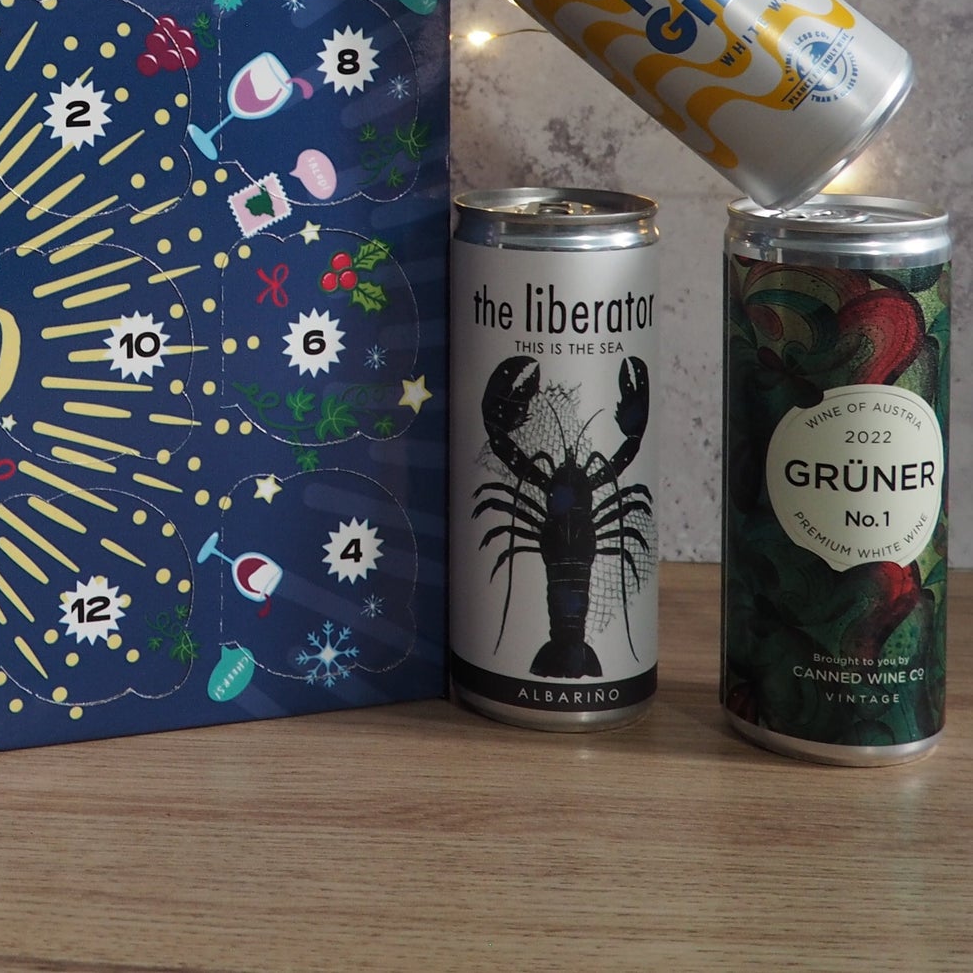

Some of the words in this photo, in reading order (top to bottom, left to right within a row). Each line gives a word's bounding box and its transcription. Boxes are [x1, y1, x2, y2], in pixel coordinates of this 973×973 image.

[720, 13, 769, 66] WHITE
[337, 48, 360, 75] 8
[65, 100, 91, 128] 2
[473, 284, 513, 330] the
[526, 283, 655, 334] liberator
[119, 331, 160, 359] 10
[303, 330, 326, 355] 6
[515, 340, 544, 354] THIS
[550, 343, 562, 355] IS
[569, 343, 594, 355] THE
[600, 342, 624, 354] SEA
[805, 406, 842, 429] WINE
[847, 402, 867, 414] OF
[873, 402, 922, 431] AUSTRIA
[845, 430, 892, 444] 2022
[784, 459, 935, 493] GRÜNER
[794, 511, 851, 556] PREMIUM
[858, 542, 901, 559] WHITE
[904, 514, 928, 544] WINE
[340, 538, 363, 563] 4
[71, 596, 111, 623] 12
[813, 653, 859, 667] Brought
[863, 658, 874, 666] to
[877, 658, 896, 667] you
[899, 656, 910, 665] by
[793, 666, 862, 684] CANNED
[867, 671, 906, 685] WINE
[518, 688, 619, 703] ALBARIÑO
[826, 692, 900, 704] VINTAGE
